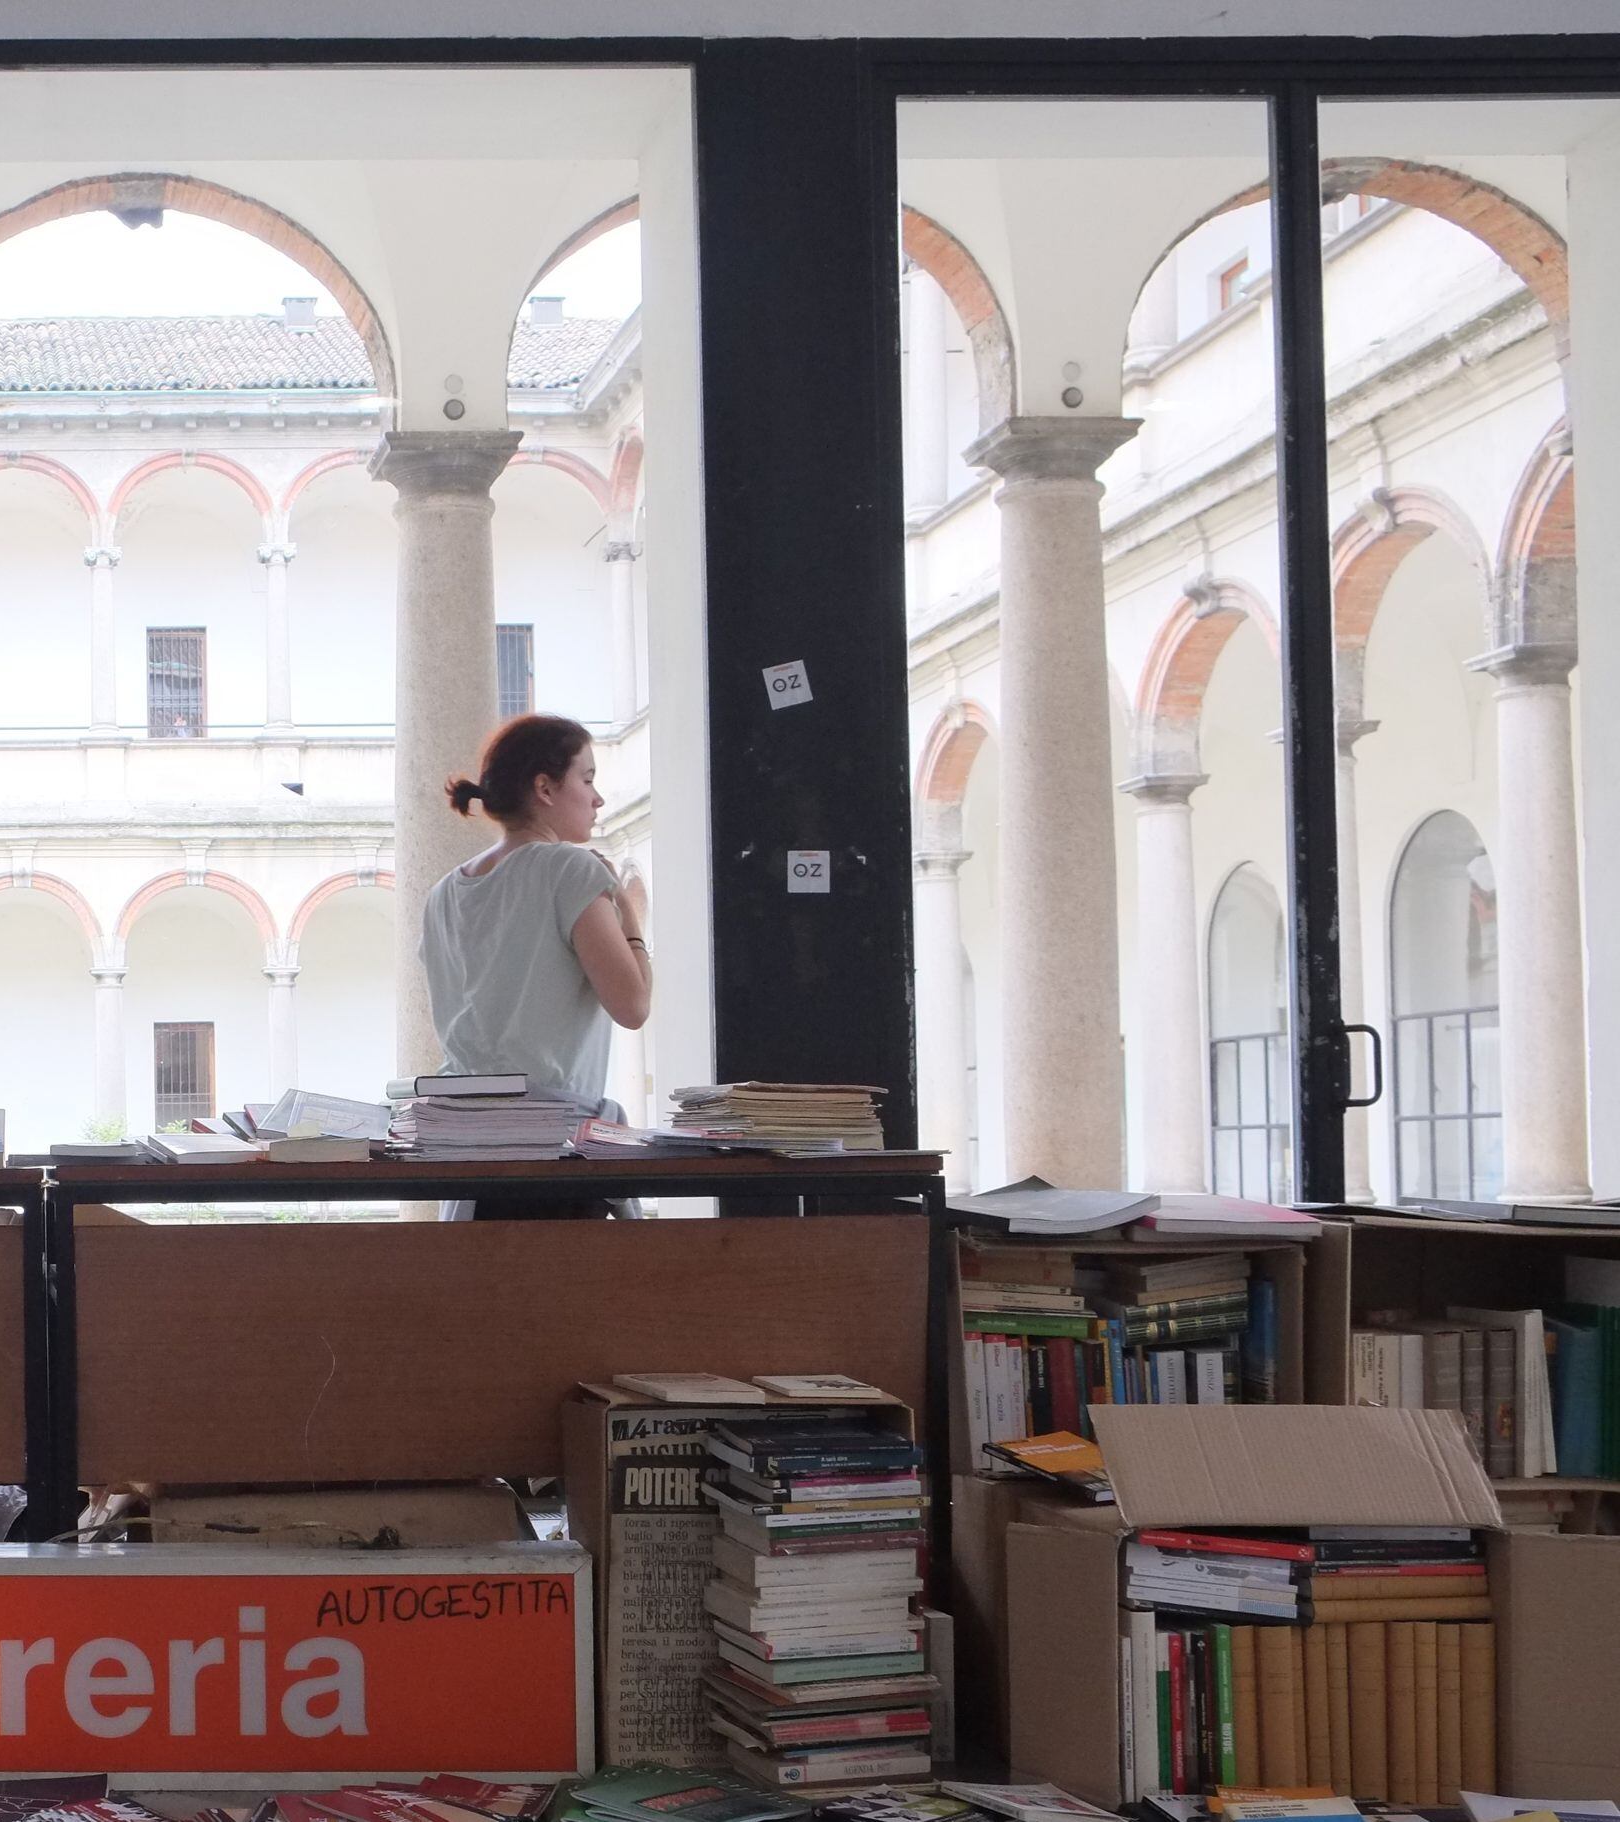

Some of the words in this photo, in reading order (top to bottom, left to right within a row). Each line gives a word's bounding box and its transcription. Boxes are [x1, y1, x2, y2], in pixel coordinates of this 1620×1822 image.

[772, 674, 802, 693] OZ
[793, 863, 822, 878] OZ
[974, 1388, 983, 1420] Argentina
[624, 1467, 700, 1506] POTERE
[624, 1531, 652, 1543] luglio
[662, 1531, 689, 1541] 1969
[317, 1580, 570, 1628] AUTOGESTITA
